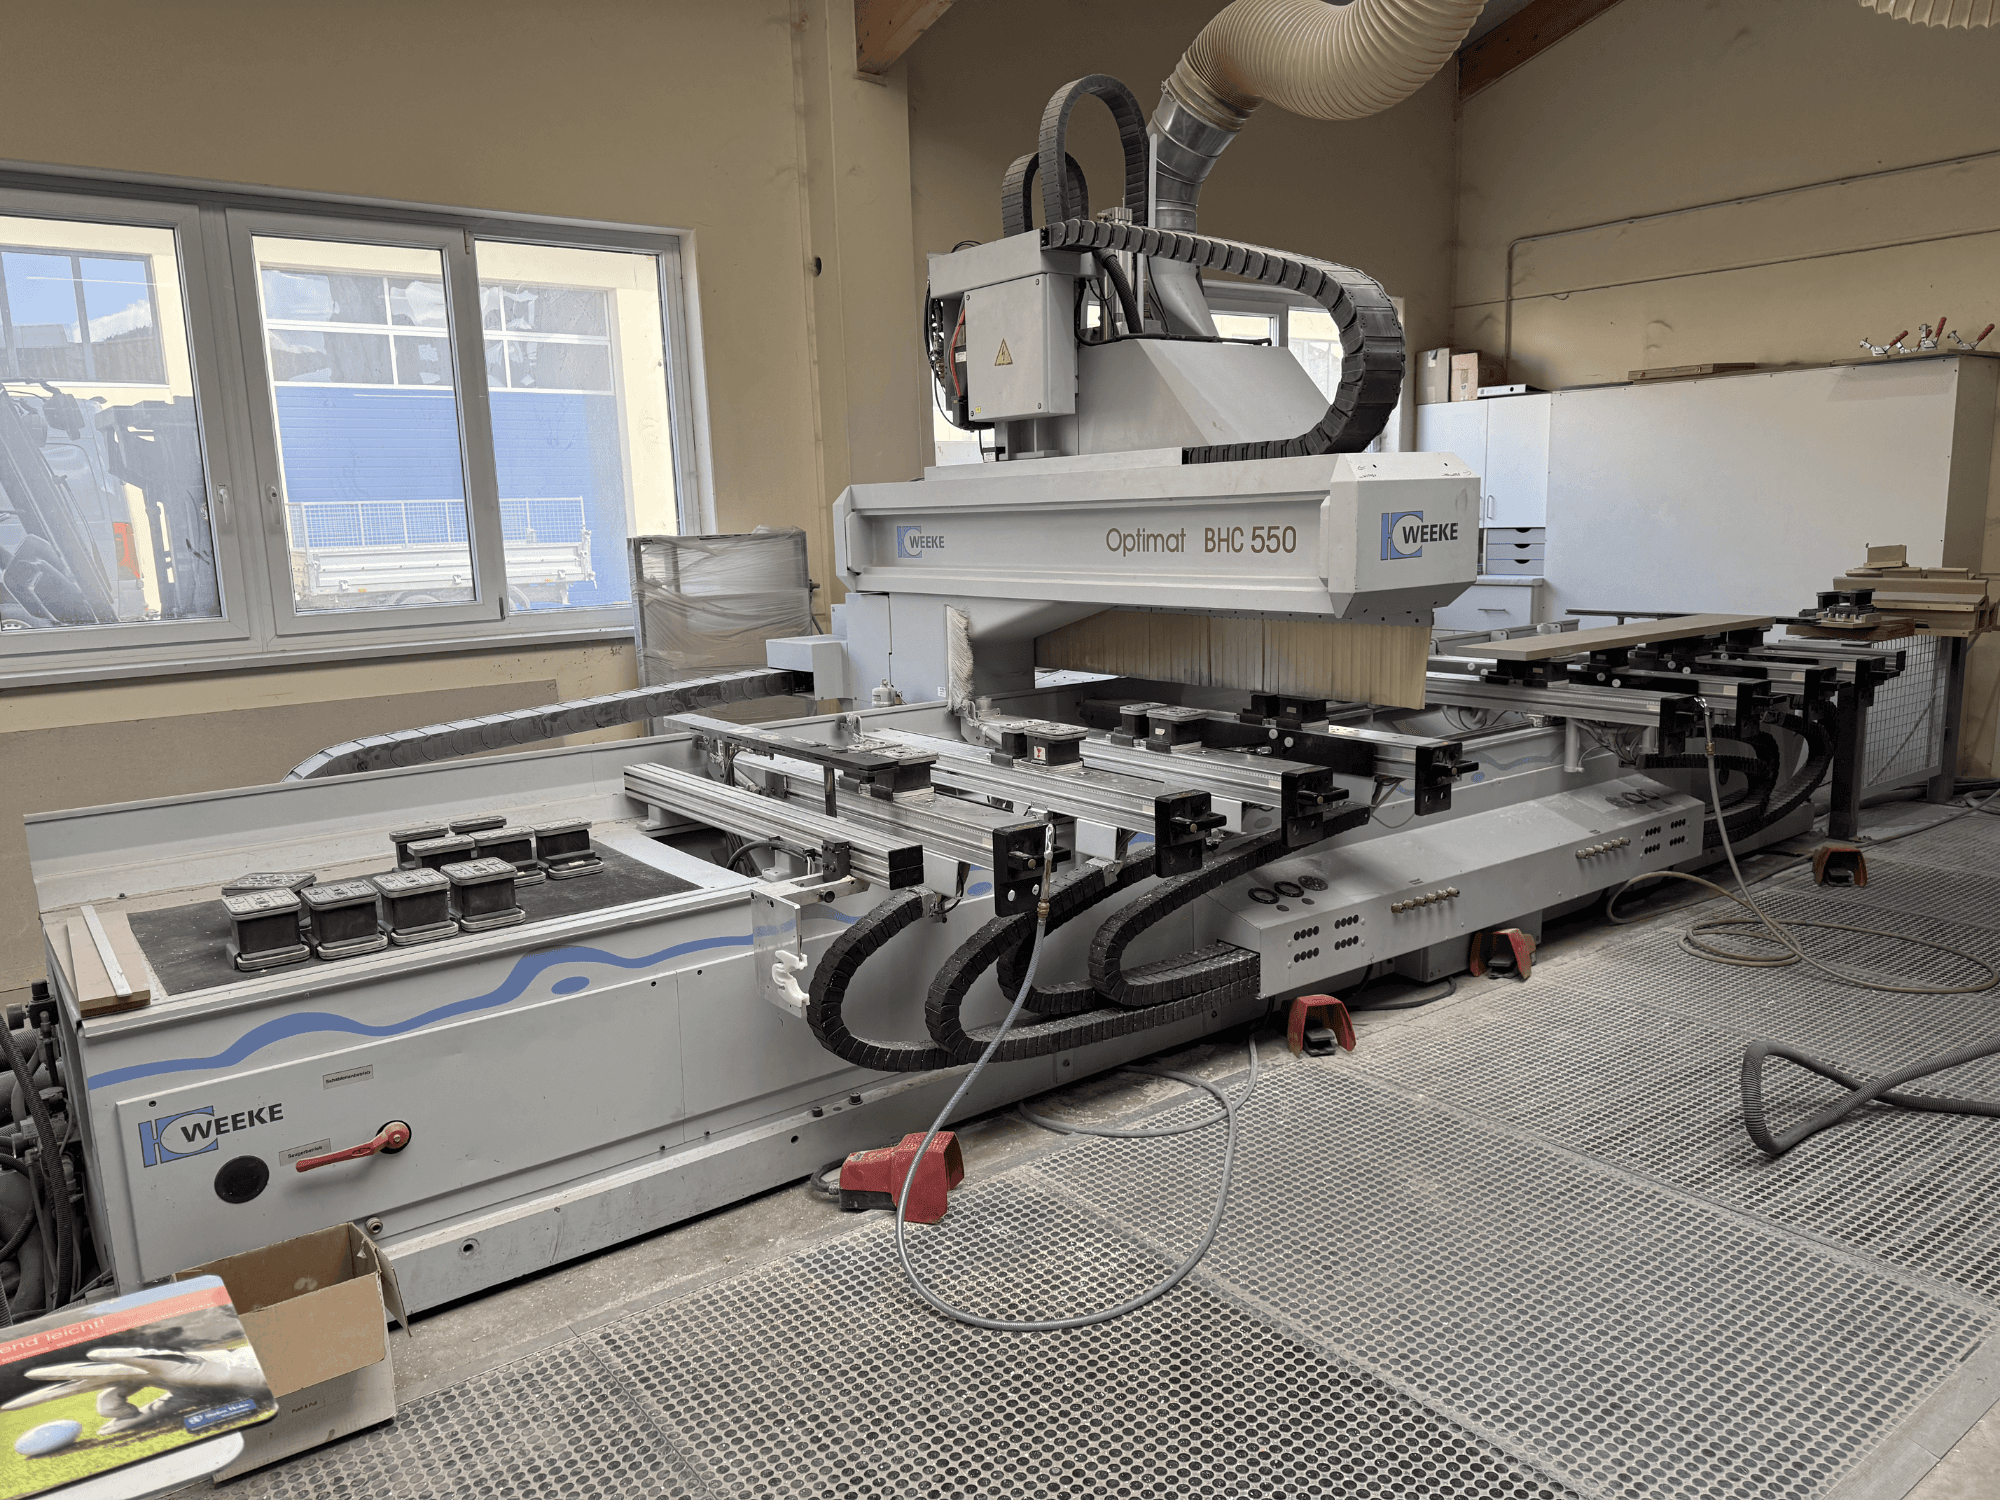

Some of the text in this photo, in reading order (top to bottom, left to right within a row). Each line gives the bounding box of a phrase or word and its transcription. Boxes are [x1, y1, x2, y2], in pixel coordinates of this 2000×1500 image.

[909, 535, 945, 549] WEEKE
[1106, 525, 1297, 557] Optimat BHC 550
[1402, 522, 1459, 544] WEEKE
[180, 1102, 284, 1143] WEEKE
